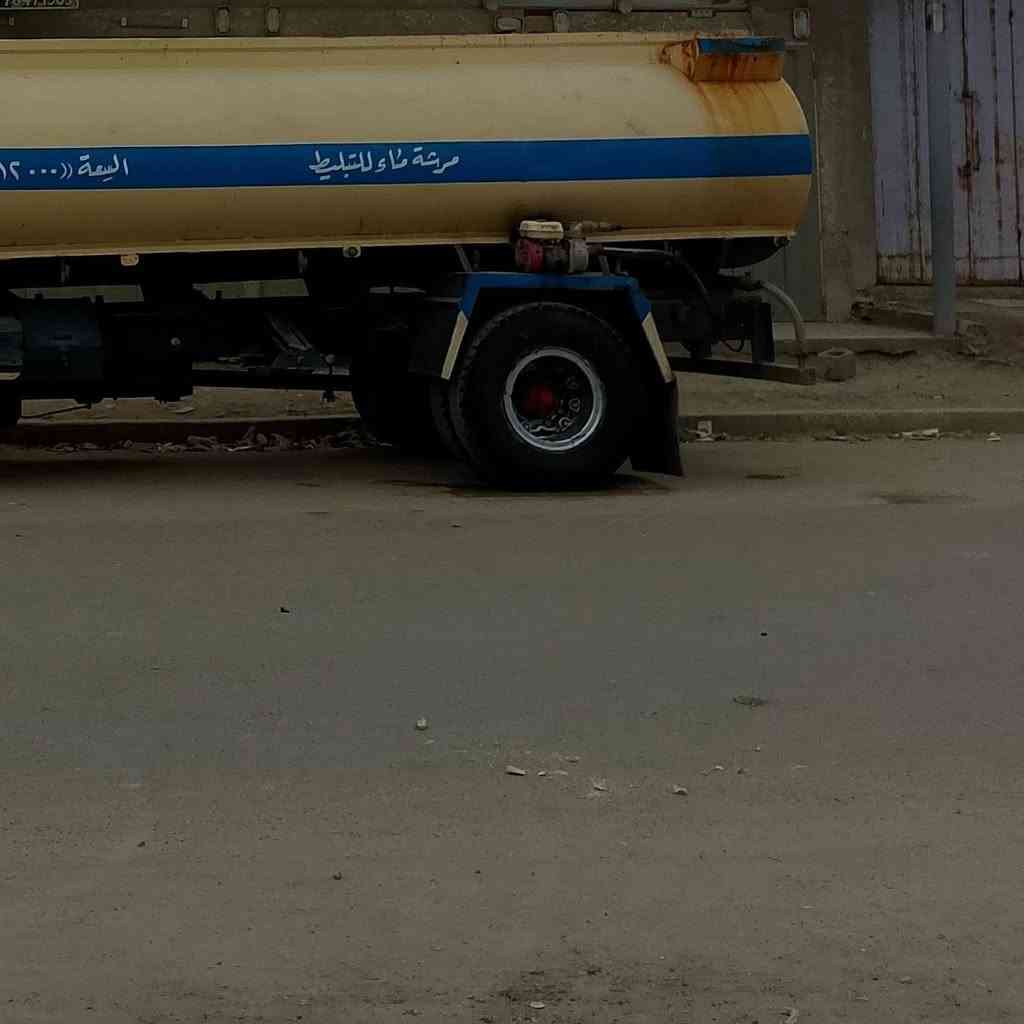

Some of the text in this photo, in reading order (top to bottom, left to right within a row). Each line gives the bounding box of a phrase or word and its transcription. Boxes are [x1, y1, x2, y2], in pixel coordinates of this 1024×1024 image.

[78, 152, 129, 182] السعة
[308, 146, 460, 180] مرشة ماء للتبليط
